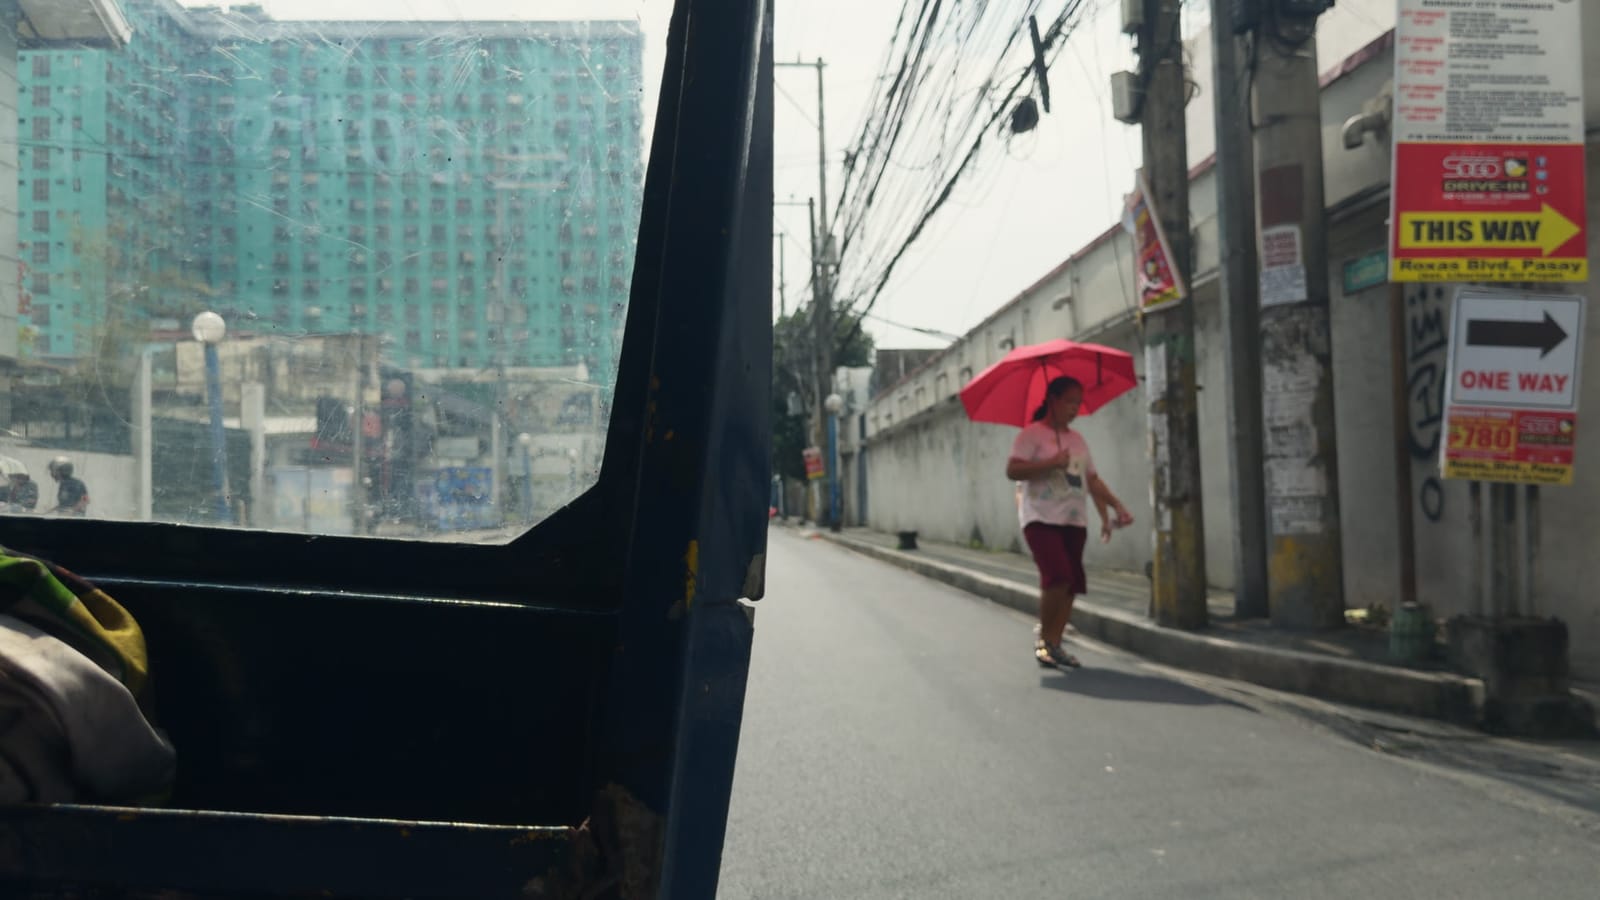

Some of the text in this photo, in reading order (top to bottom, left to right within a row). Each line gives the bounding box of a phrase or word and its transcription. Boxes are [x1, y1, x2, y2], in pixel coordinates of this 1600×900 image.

[1444, 181, 1527, 192] DRIVE-IN
[1410, 220, 1540, 241] THIS WAY
[1522, 260, 1581, 272] Pasay
[1460, 369, 1568, 394] ONE WAY
